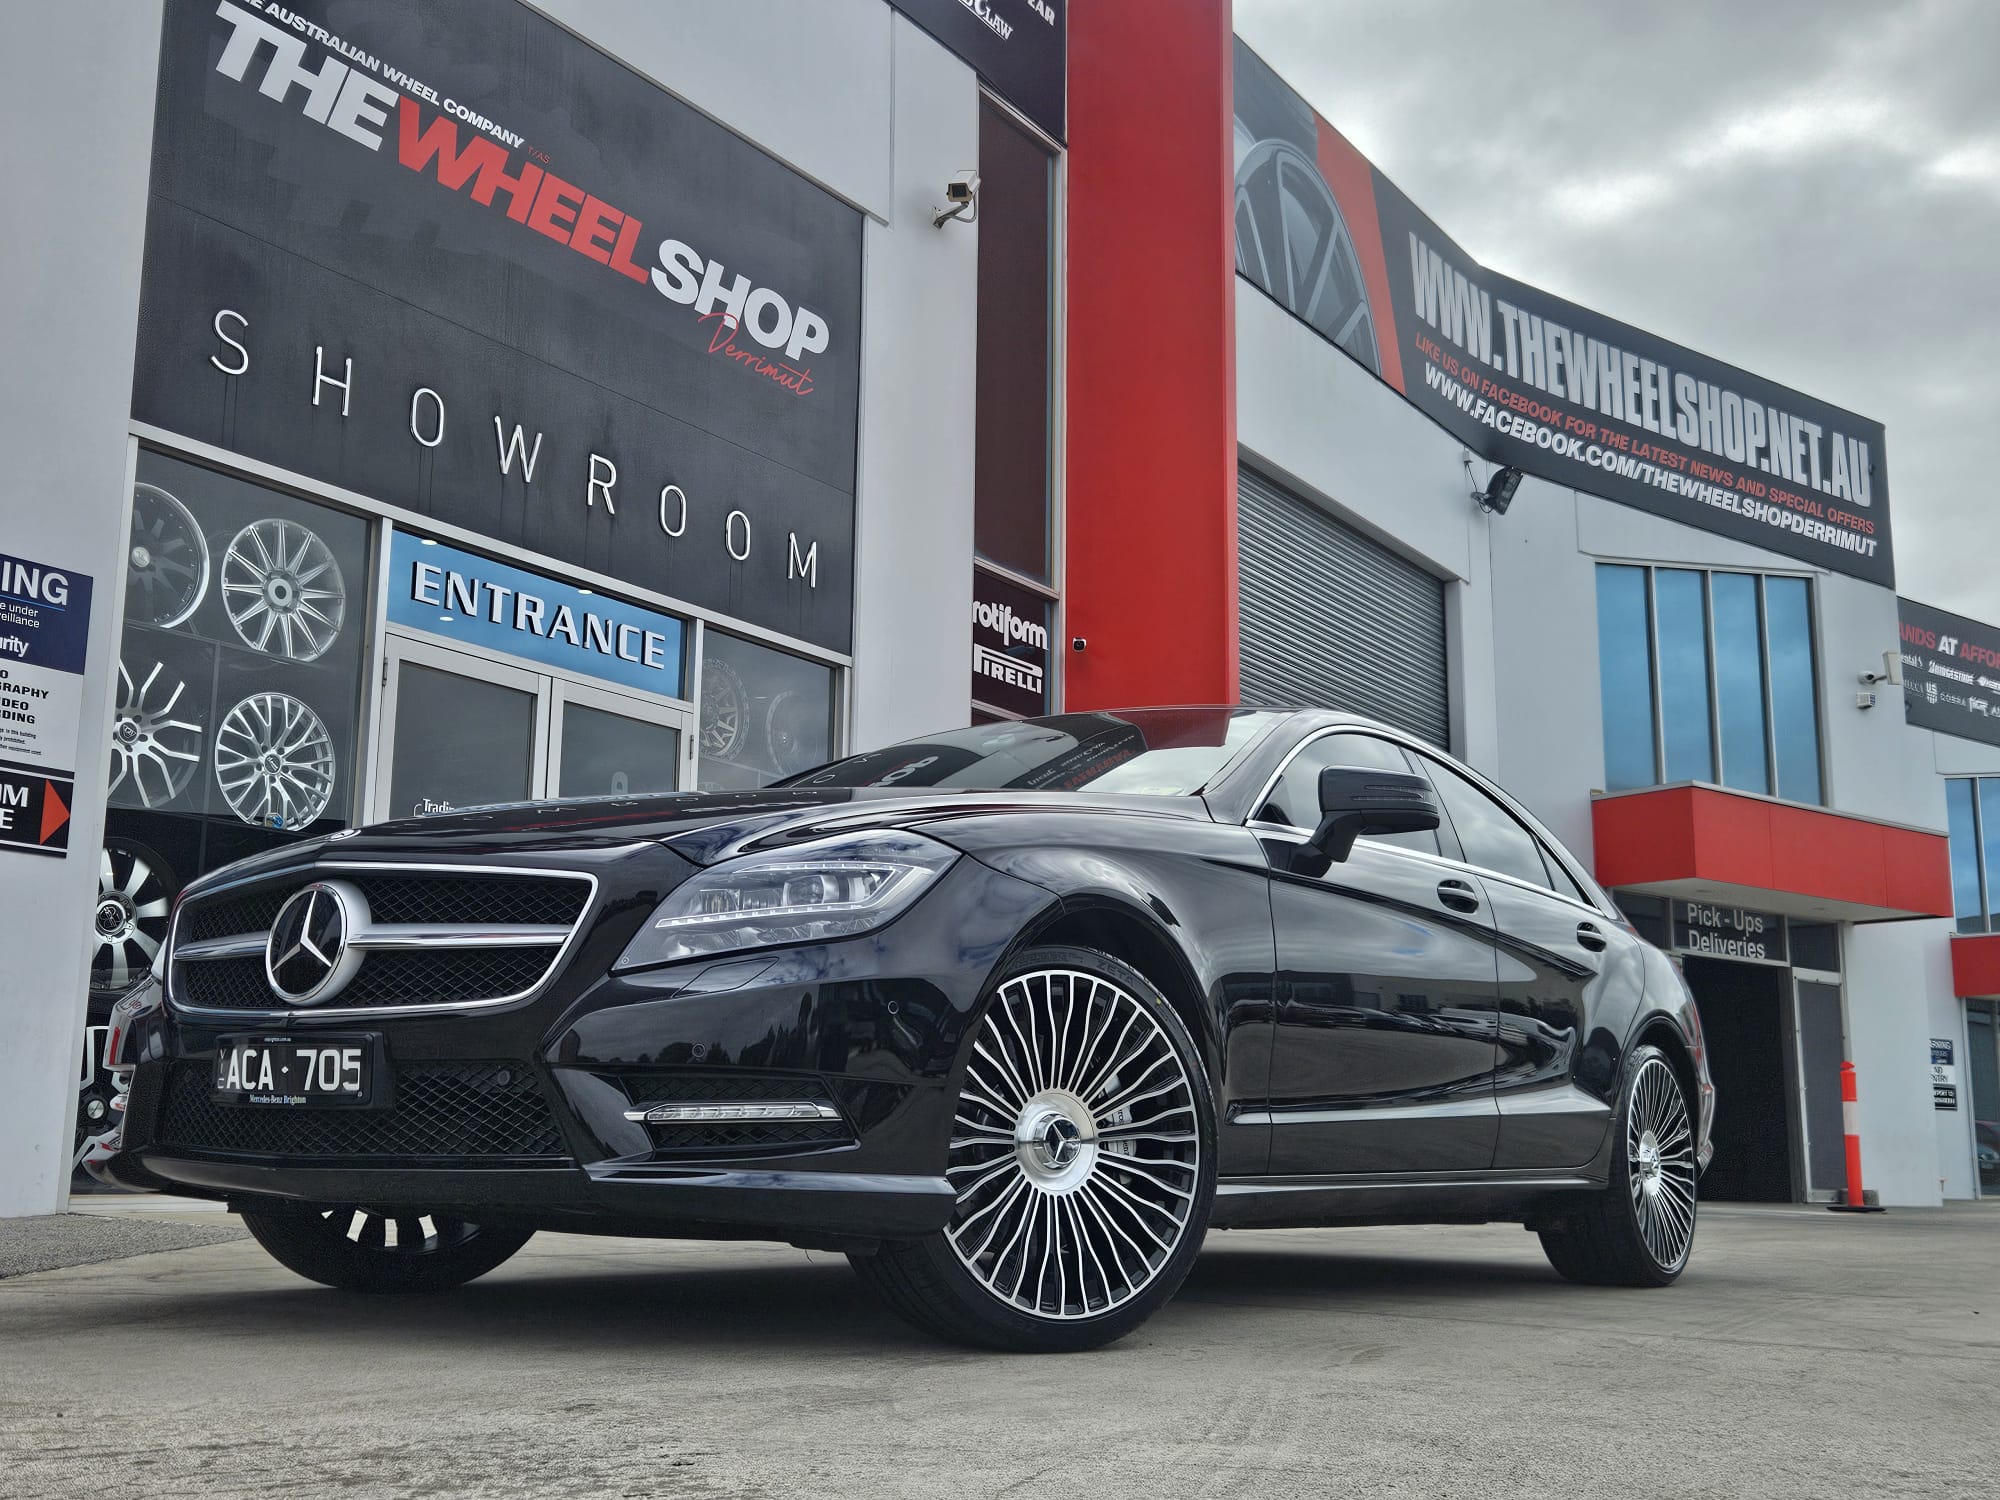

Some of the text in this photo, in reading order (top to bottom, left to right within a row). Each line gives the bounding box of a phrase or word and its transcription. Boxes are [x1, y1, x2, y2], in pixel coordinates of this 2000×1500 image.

[265, 2, 381, 73] AUSTRALIAN
[383, 63, 440, 107] WHEEL
[443, 98, 525, 149] COMPANY
[651, 239, 830, 361] SHOP
[698, 312, 814, 396] Derrimut
[1408, 231, 1871, 508] WWW.THEWHEELSHOP.NET.AU
[1415, 332, 1875, 535] LIKE US ON FACEBOOK FOR THE LATEST NEWS AND SPECIAL OFFERS
[1425, 362, 1877, 558] WWW.FACEBOOK.COM/THEWHEELSHOPDERRIMUT
[9, 604, 39, 617] under
[413, 560, 666, 670] ENTRANCE
[972, 600, 1049, 651] rotiform
[973, 643, 1043, 694] PIRELLI
[1937, 635, 1958, 656] AT
[0, 697, 29, 711] DEO
[423, 798, 455, 813] Tradi
[1686, 903, 1722, 928] Pick
[1733, 909, 1764, 937] Ups
[1688, 929, 1766, 960] Deliveries
[226, 1049, 362, 1091] ACA 705
